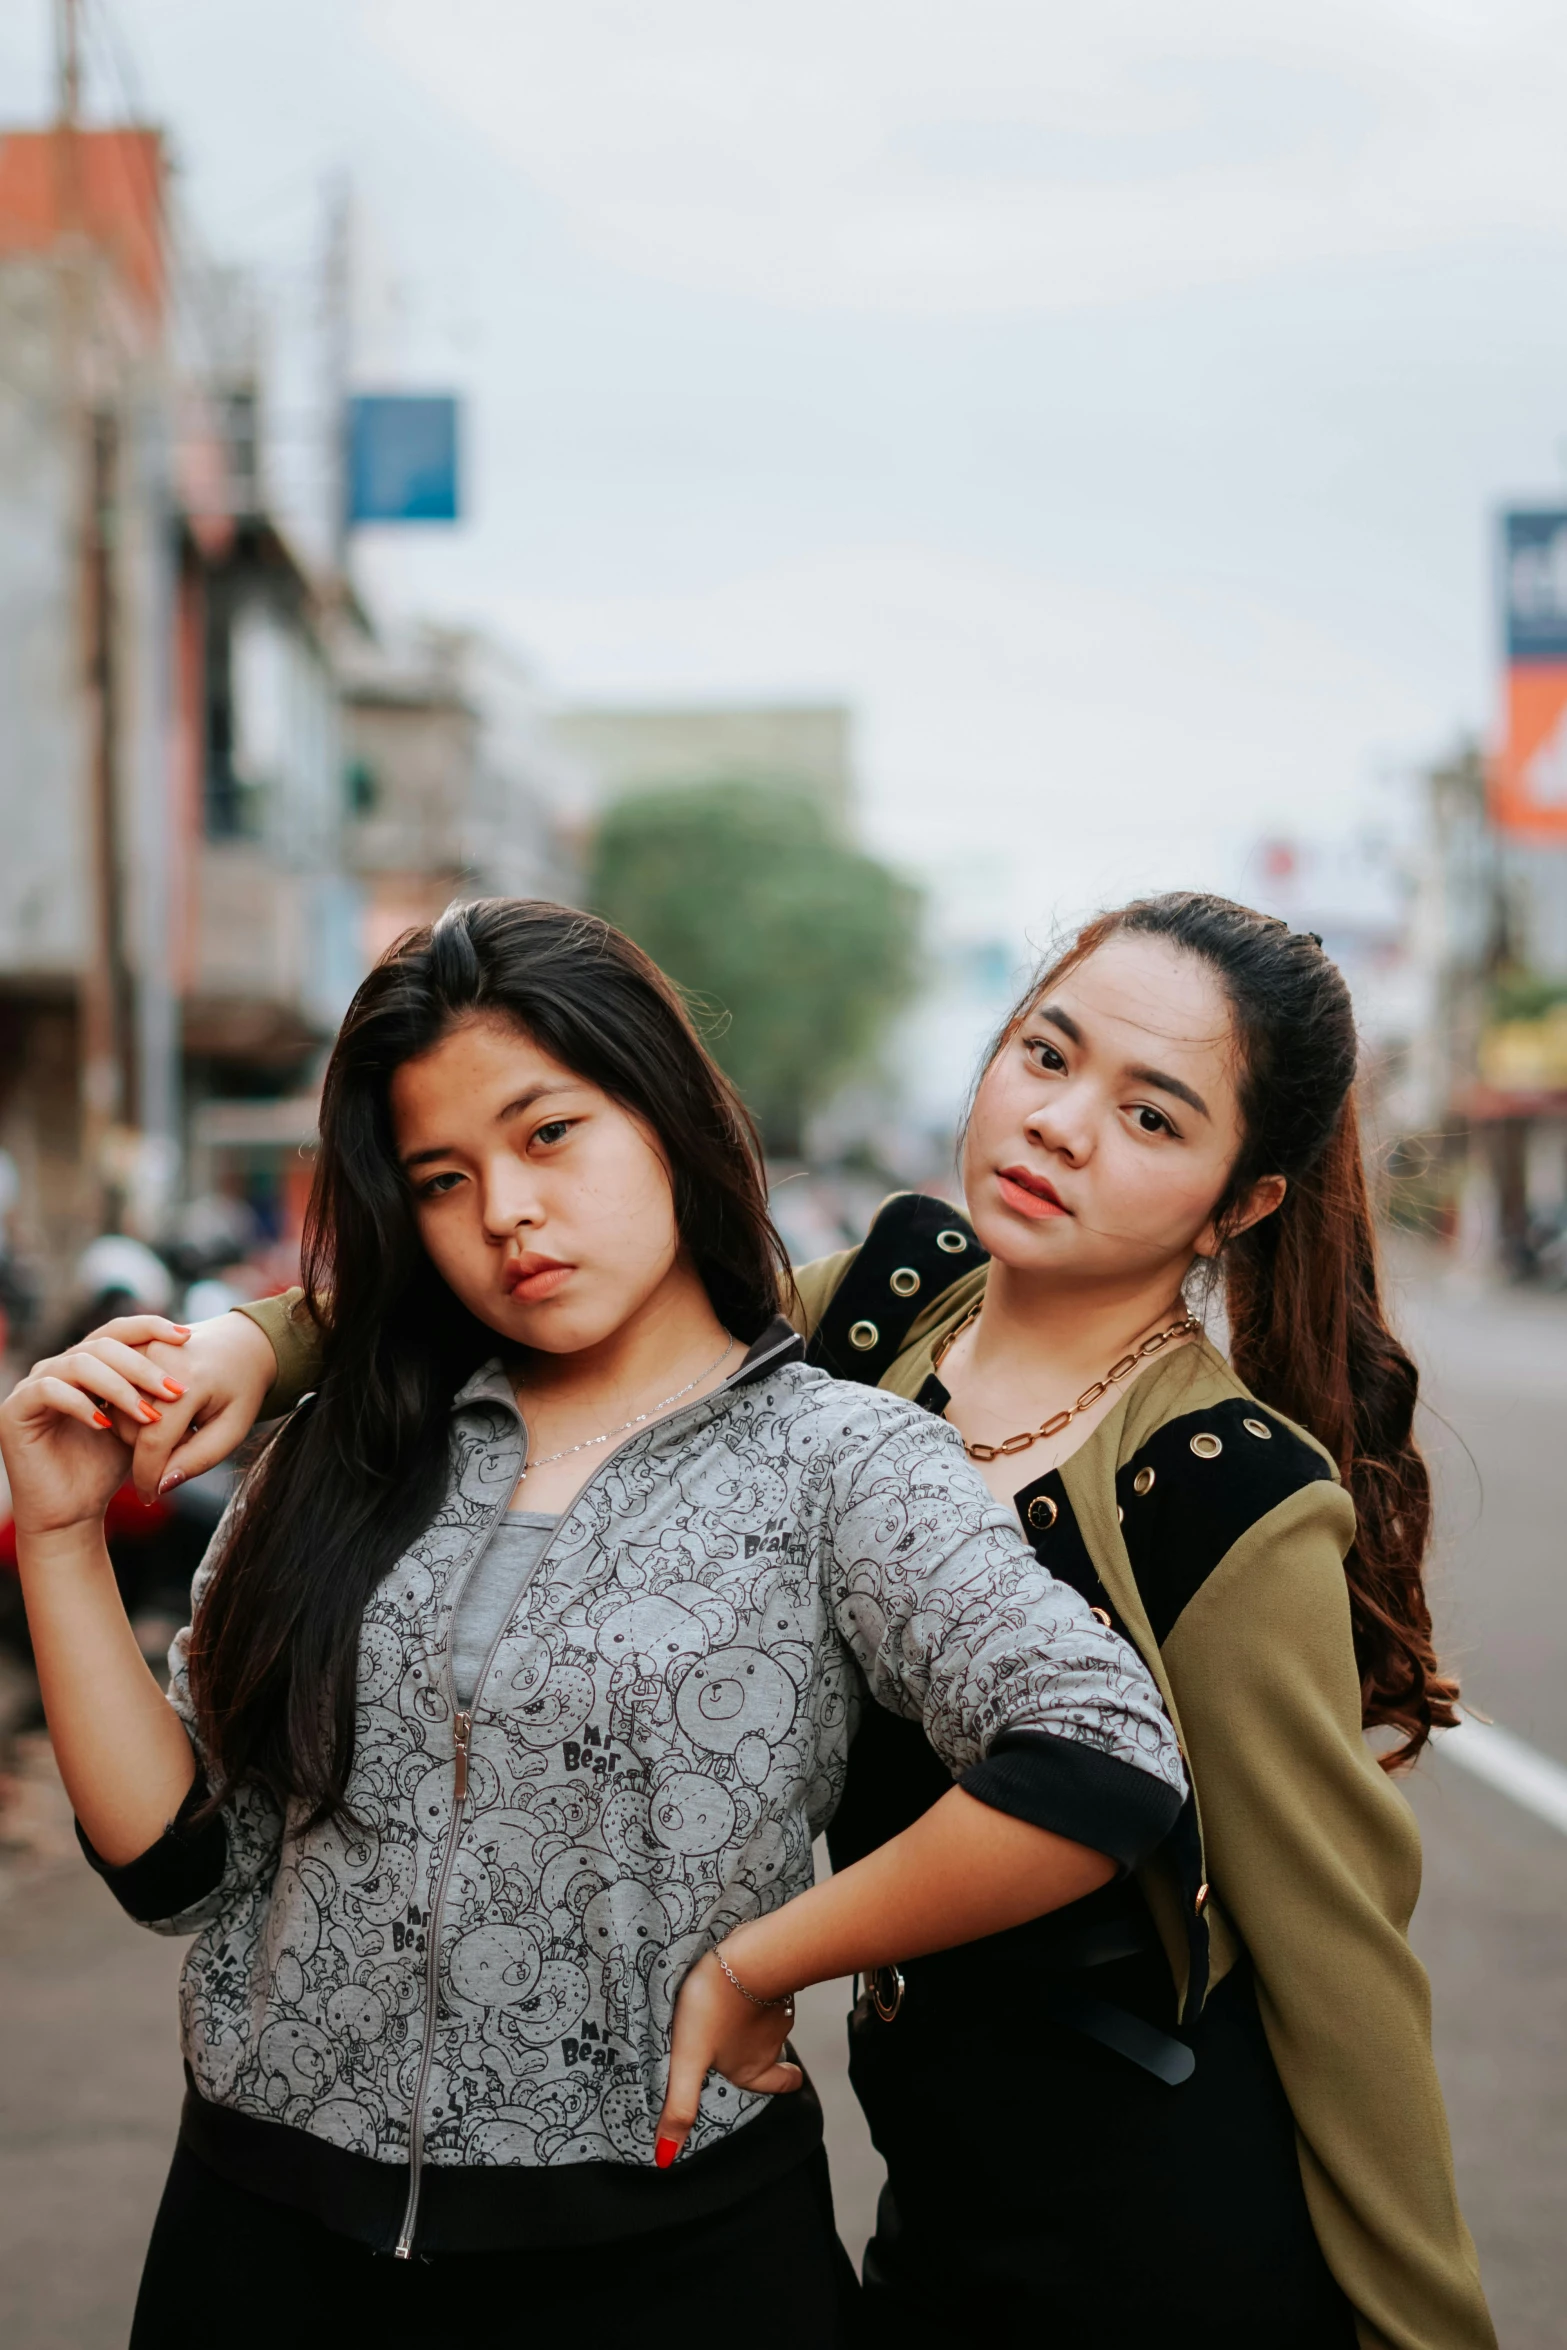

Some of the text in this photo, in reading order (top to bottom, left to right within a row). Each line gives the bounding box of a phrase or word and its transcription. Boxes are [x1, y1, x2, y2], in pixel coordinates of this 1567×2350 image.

[583, 1722, 615, 1750] Mr
[562, 1741, 622, 1774] Bear
[392, 1921, 430, 1953] Bea
[581, 2018, 613, 2044] Mr
[561, 2037, 620, 2067] Bear
